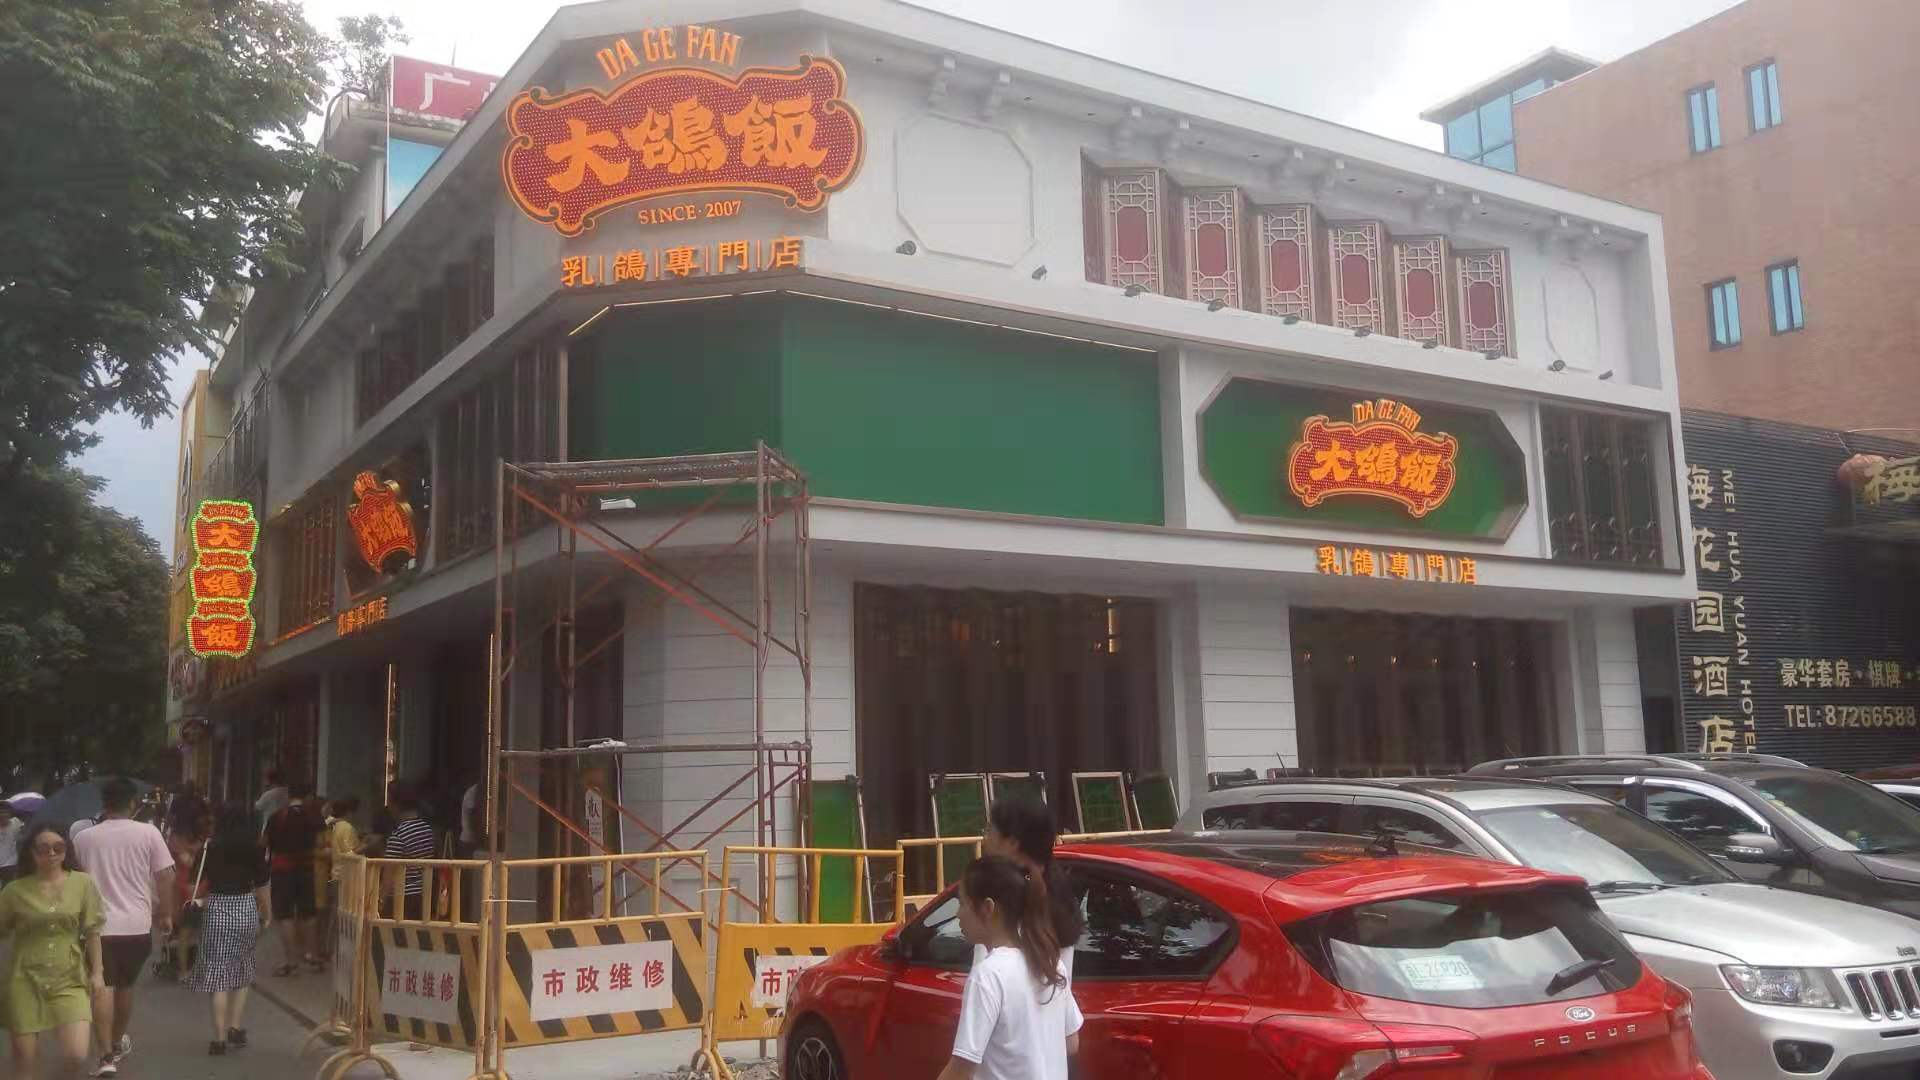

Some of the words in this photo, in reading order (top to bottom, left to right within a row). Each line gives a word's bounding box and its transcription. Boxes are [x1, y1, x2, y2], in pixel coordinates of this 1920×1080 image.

[595, 38, 641, 80] DA
[642, 26, 677, 62] GE
[687, 25, 742, 66] FAN
[544, 95, 829, 194] 大鴿飯
[1353, 400, 1375, 423] DA
[1376, 398, 1396, 420] GE
[1397, 401, 1422, 432] FAN
[1310, 440, 1442, 495] 大鴿飯
[1721, 469, 1737, 513] MEI
[1726, 531, 1742, 583] HUA
[1686, 463, 1736, 760] 梅花园酒店
[1733, 596, 1750, 666] YUAN
[388, 966, 458, 1003] 市政维修
[542, 957, 665, 998] 市政维修
[1534, 1023, 1637, 1048] FOCUS
